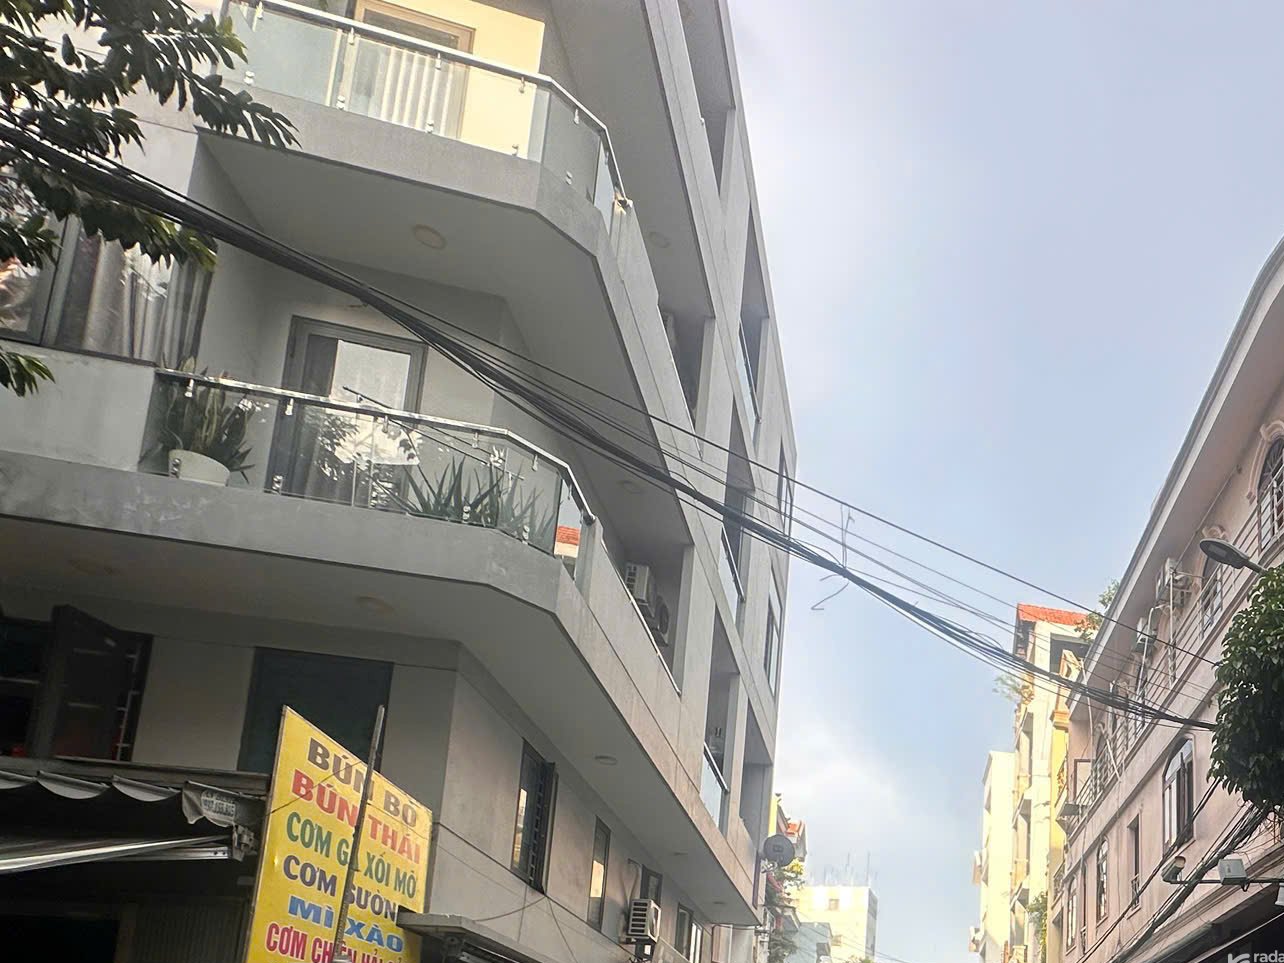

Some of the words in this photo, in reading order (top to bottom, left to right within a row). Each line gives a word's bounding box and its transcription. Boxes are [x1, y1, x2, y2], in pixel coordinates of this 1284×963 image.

[287, 811, 332, 858] CƠM
[292, 768, 359, 828] BÚN
[367, 814, 421, 864] THÁI
[283, 854, 337, 897] CƠM
[266, 922, 308, 960] CƠM
[344, 917, 404, 952] XÀO
